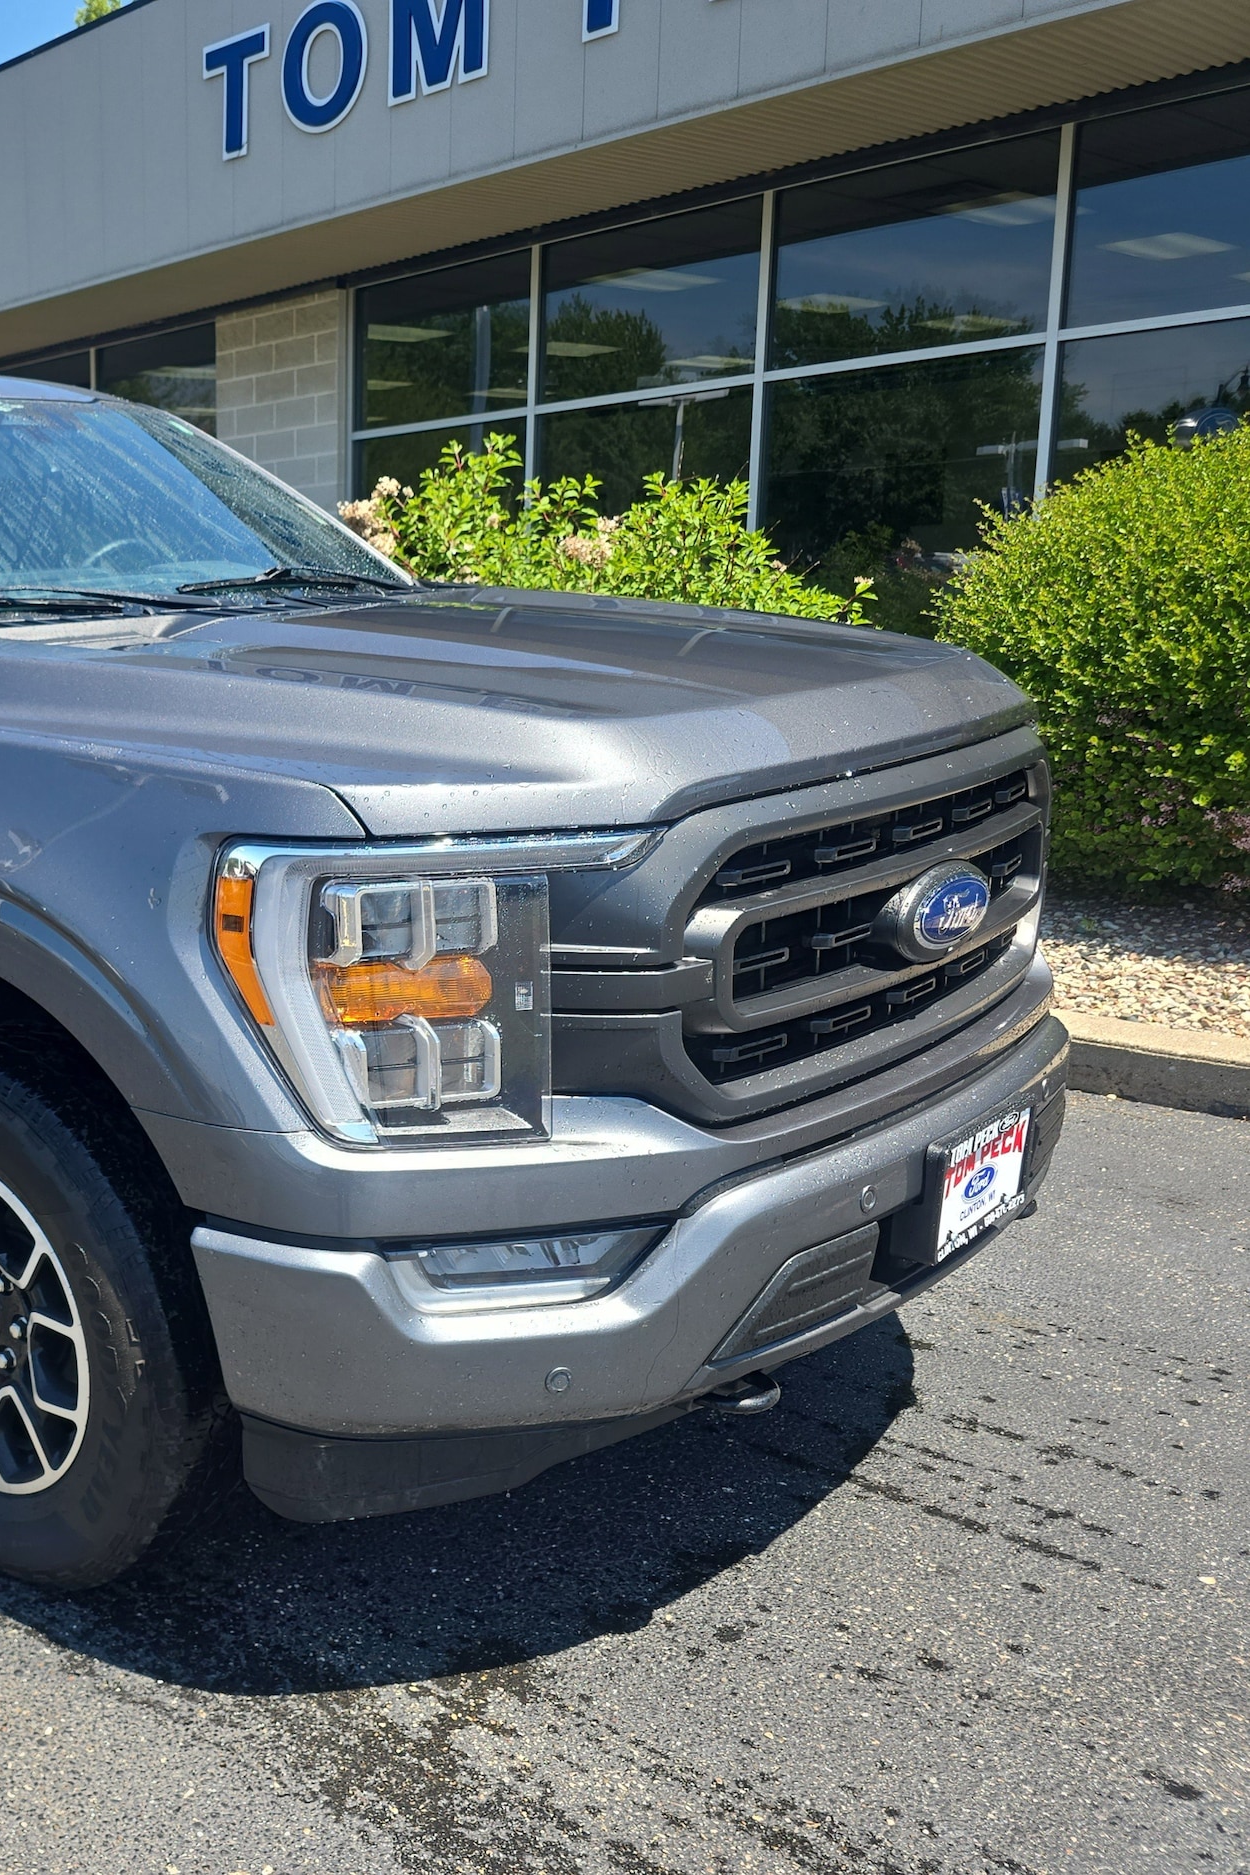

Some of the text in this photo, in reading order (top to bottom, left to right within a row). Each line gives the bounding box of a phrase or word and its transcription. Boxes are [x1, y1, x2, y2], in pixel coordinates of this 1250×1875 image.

[202, 0, 489, 162] TOM
[938, 888, 980, 936] Ford
[944, 1120, 1027, 1200] TOM PECK
[968, 1169, 992, 1198] Ford
